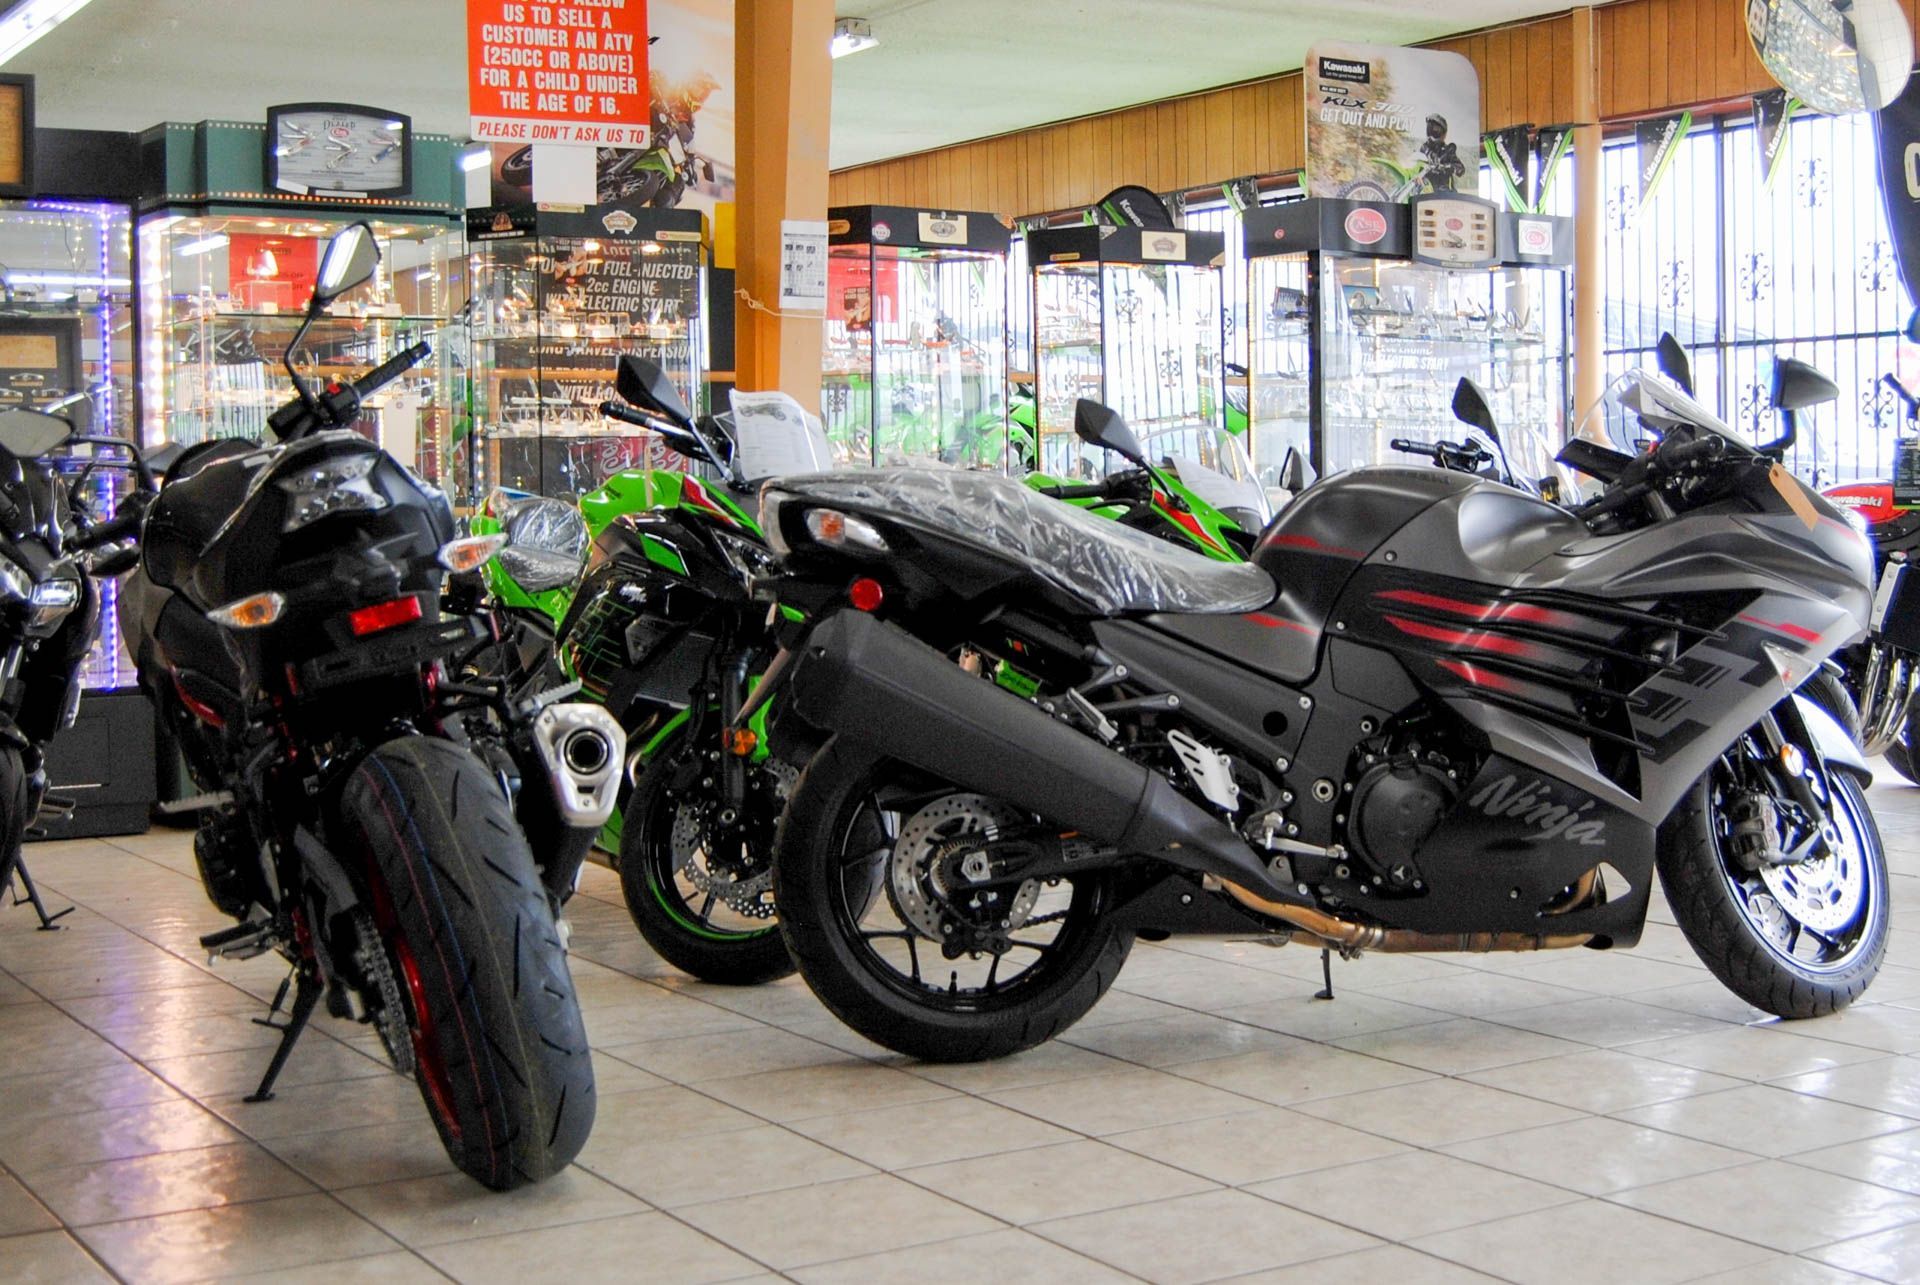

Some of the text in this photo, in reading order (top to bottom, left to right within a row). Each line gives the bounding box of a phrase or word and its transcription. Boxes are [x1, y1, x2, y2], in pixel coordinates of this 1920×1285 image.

[503, 4, 525, 23] US
[531, 7, 551, 25] TO
[558, 8, 595, 28] SELL
[601, 12, 612, 29] A
[482, 24, 633, 51] CUSTOMER AN ATV
[483, 45, 634, 74] (250CC OR ABOVE)
[1323, 60, 1366, 75] Kawasaki
[480, 68, 638, 95] FOR A CHILD UNDER
[499, 91, 621, 115] THE AGE OF 16.
[1322, 96, 1367, 109] KLX
[1320, 107, 1417, 132] GET OUT AND PLAY
[478, 122, 644, 144] PLEASE DON'T ASK US TO
[612, 279, 657, 296] ENGINE
[583, 294, 640, 312] ELECTRIC
[1469, 775, 1606, 845] Ninja
